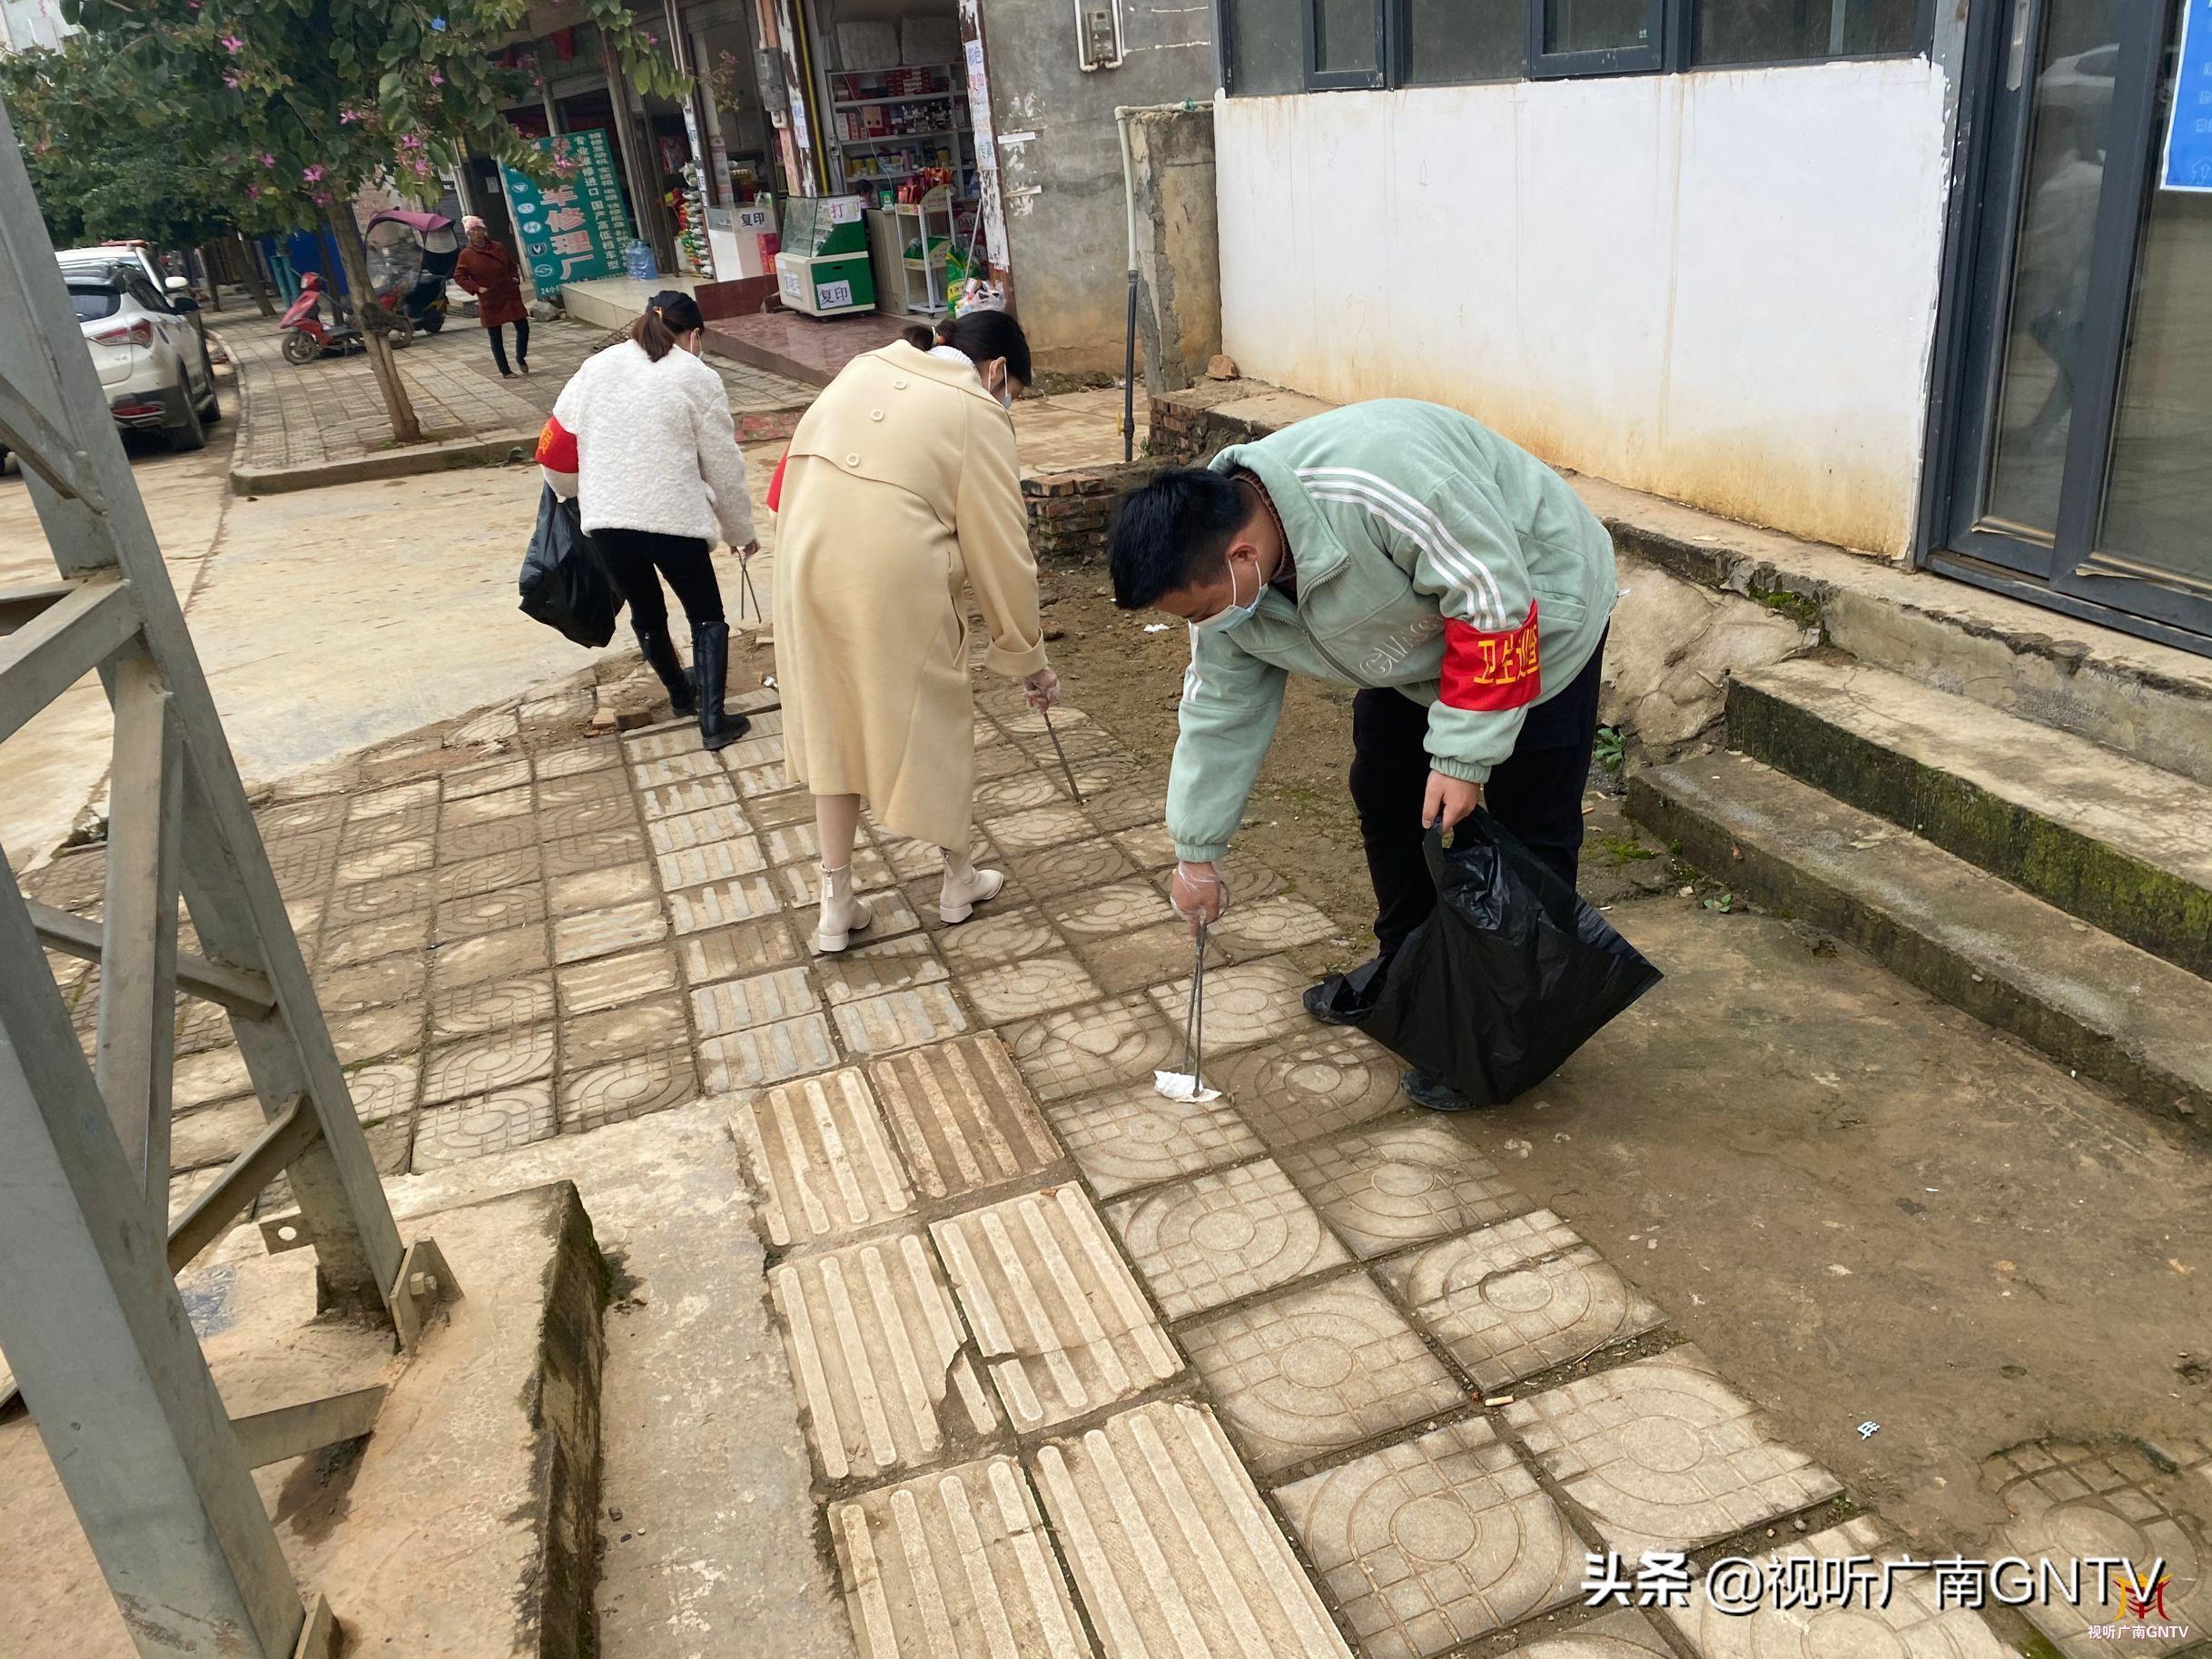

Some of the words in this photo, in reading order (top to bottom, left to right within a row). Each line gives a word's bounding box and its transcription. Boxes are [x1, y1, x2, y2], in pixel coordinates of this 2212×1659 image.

[574, 136, 599, 196] 专业维修进口
[591, 200, 619, 270] 国产高低档车型
[741, 212, 765, 227] 复印
[820, 286, 848, 305] 复印
